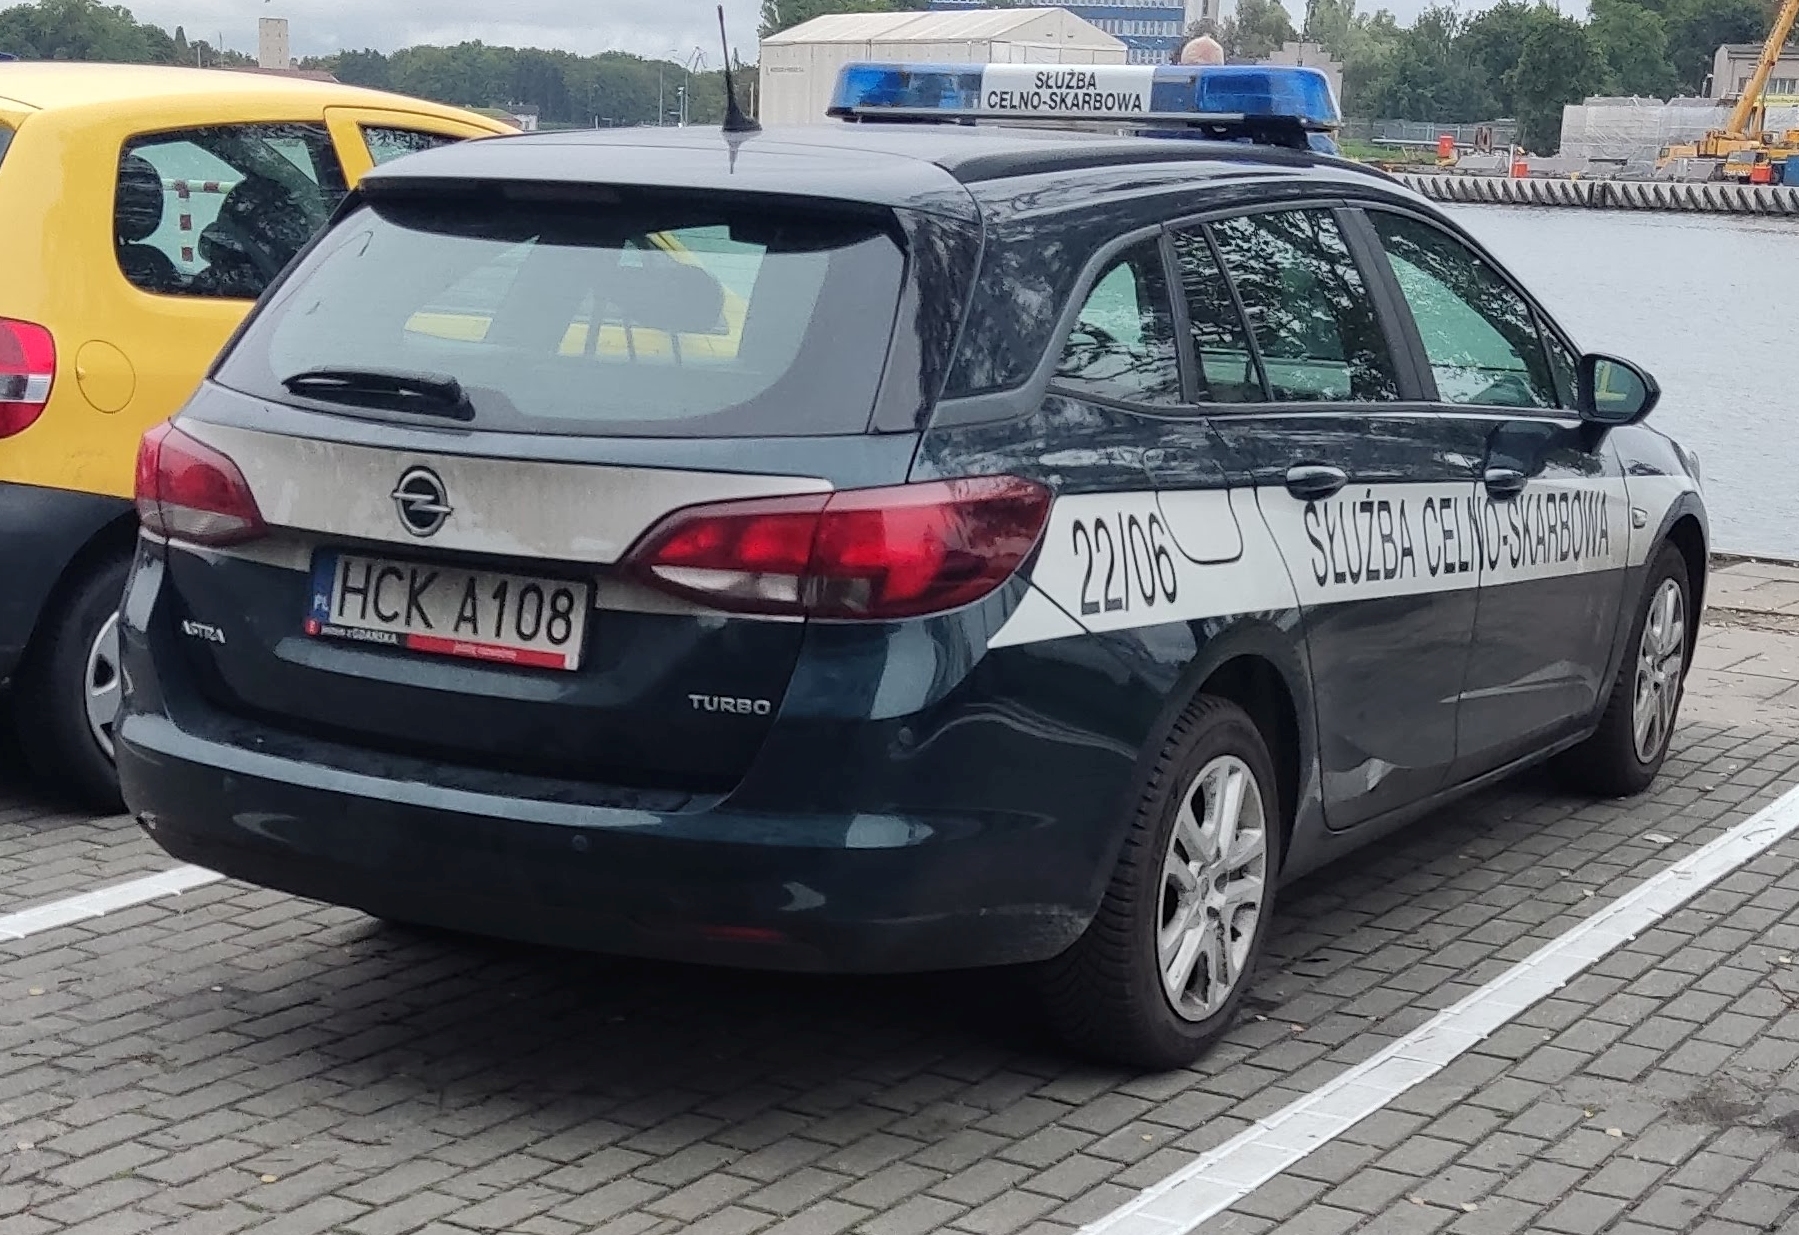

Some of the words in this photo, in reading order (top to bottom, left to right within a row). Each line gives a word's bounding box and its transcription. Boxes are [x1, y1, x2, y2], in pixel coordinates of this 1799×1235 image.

[987, 90, 1142, 112] CELNO-SKARBOWA
[1034, 69, 1097, 90] SŁUŻBA
[1072, 511, 1177, 616] 22/06
[1303, 488, 1416, 587] SŁUŻBA
[1422, 489, 1609, 577] CELNO-SKARBOWA
[338, 561, 439, 629] HCK
[453, 576, 575, 645] A108
[687, 693, 771, 715] TURBO
